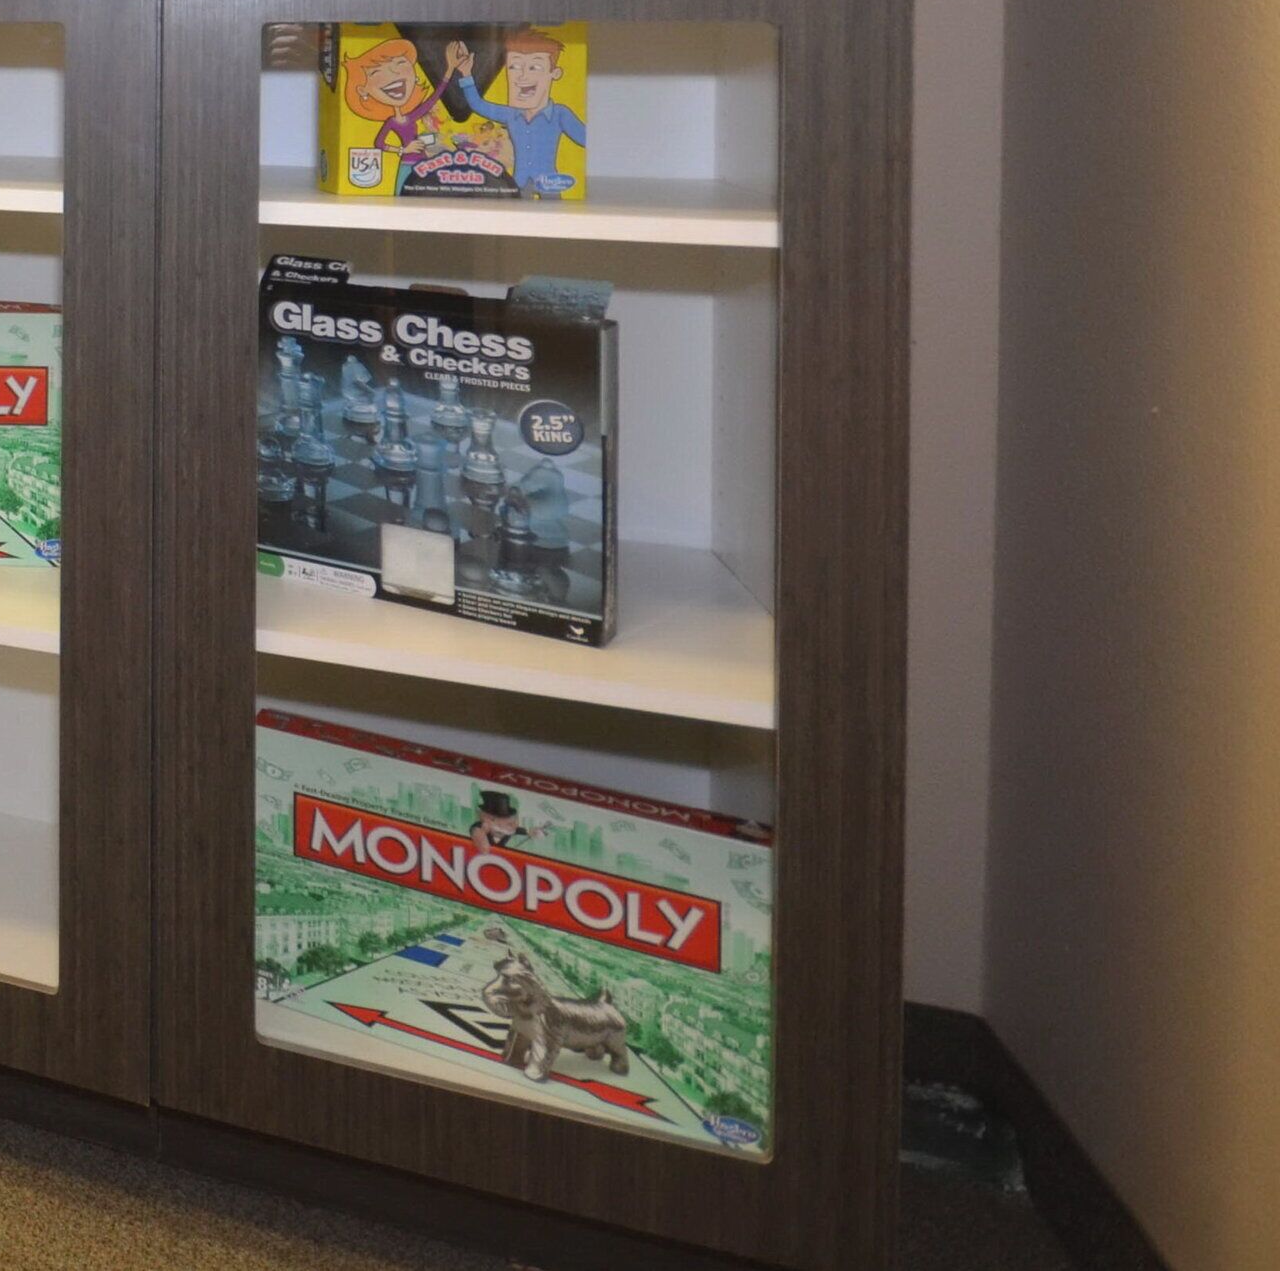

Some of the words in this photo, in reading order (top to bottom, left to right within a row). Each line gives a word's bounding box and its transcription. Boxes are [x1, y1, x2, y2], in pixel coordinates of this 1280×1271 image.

[352, 156, 380, 172] USA
[414, 152, 453, 178] Fast
[454, 151, 468, 165] &
[469, 152, 503, 177] Fun
[437, 169, 484, 184] Trivia
[276, 256, 322, 270] Glass
[285, 271, 339, 284] Checkers
[272, 300, 383, 344] Glass
[394, 313, 533, 362] Chess
[380, 344, 402, 364] &
[408, 348, 531, 381] Checkers
[424, 372, 450, 381] CLEAR
[460, 376, 499, 388] FROSTED
[500, 380, 531, 392] PIECES
[533, 430, 573, 443] KING
[498, 773, 690, 821] MONOPOLY
[310, 807, 704, 950] MONOPOLY
